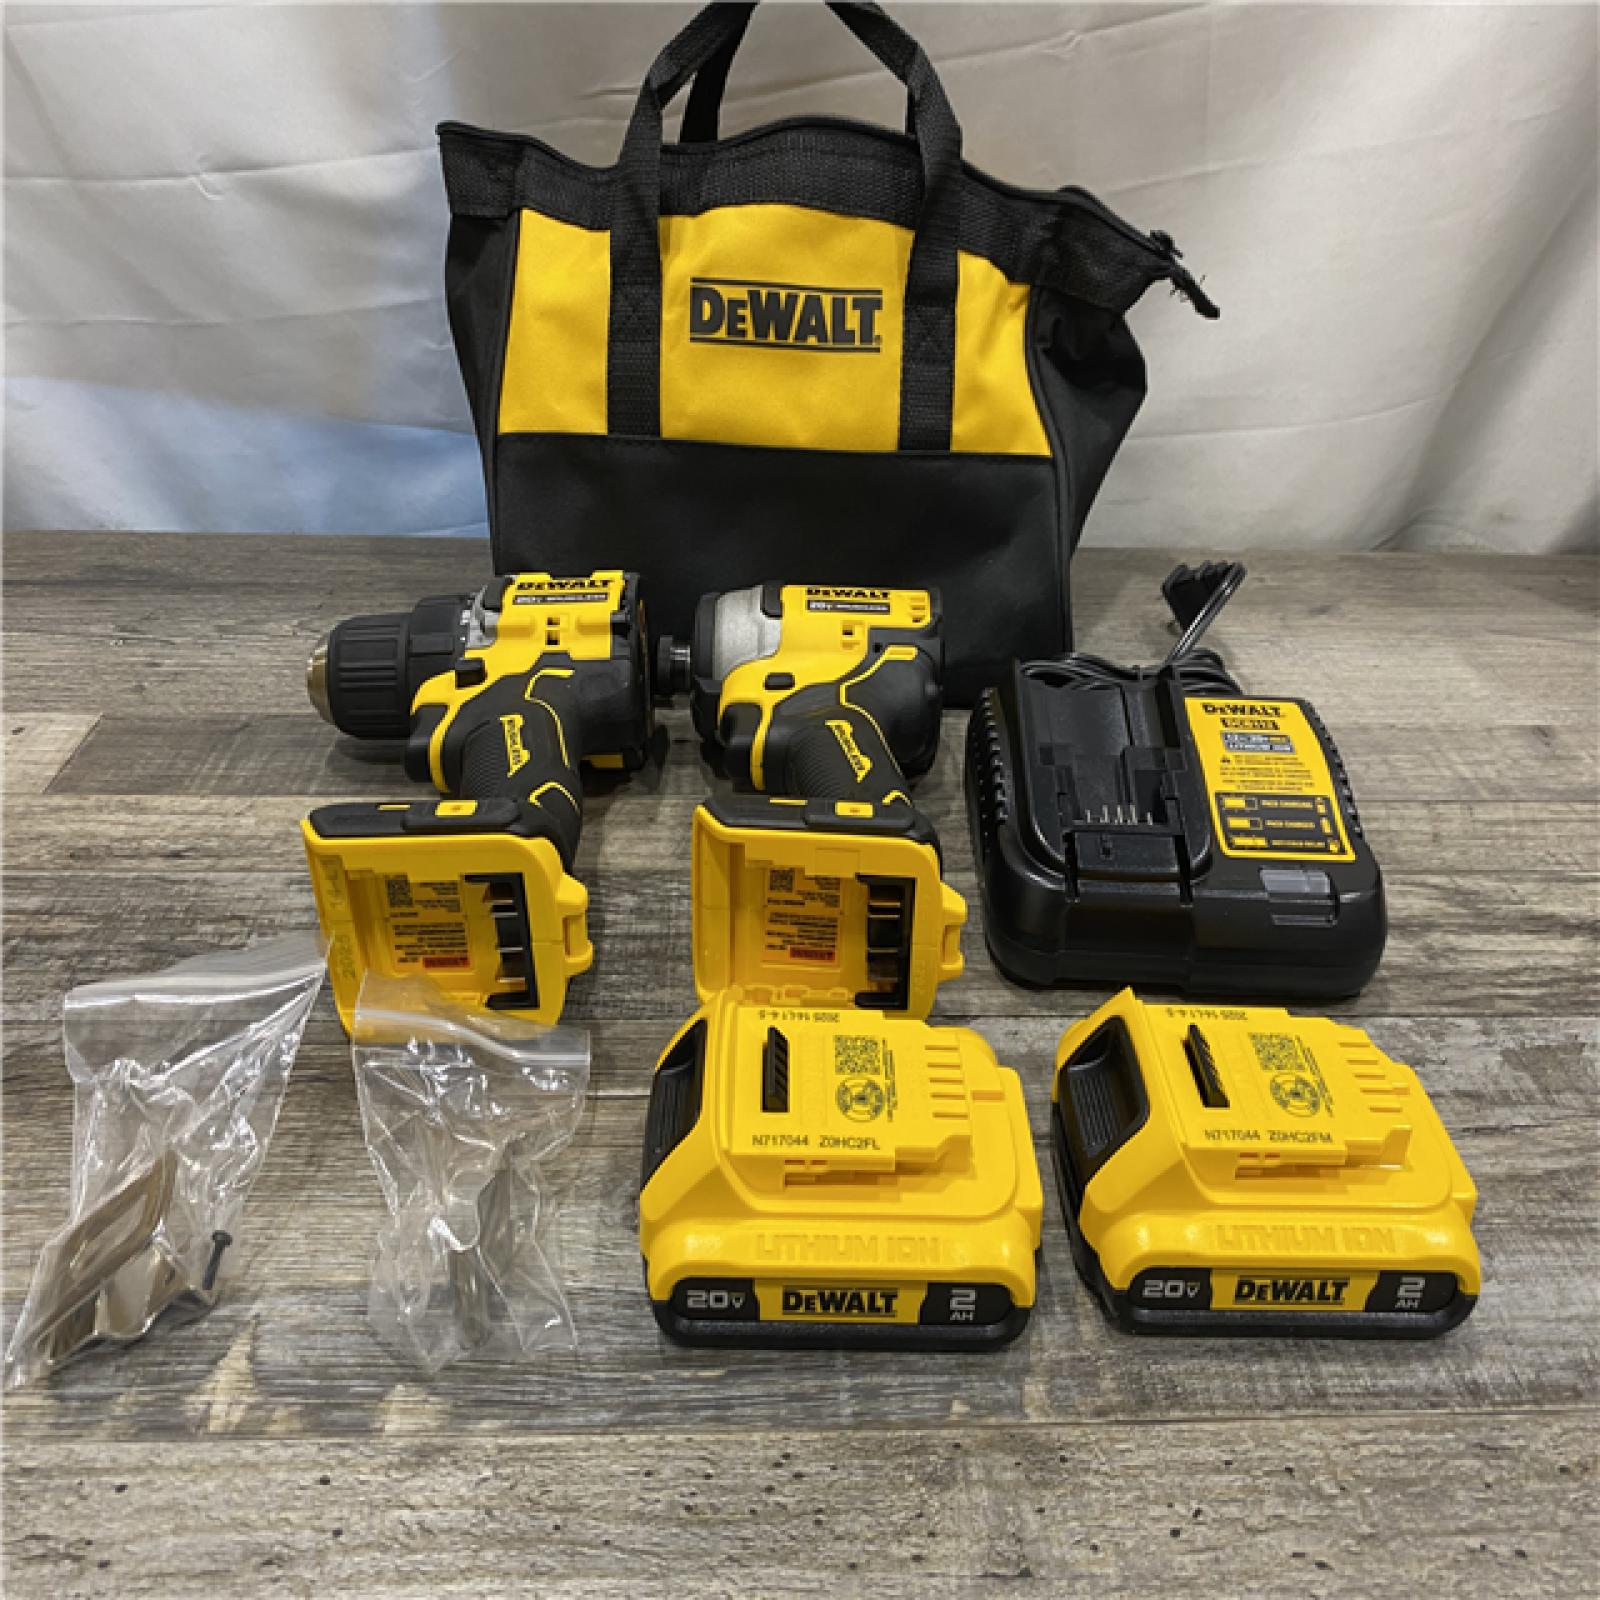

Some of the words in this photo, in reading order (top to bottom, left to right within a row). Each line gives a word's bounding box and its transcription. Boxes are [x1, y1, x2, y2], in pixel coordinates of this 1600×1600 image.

[690, 287, 882, 345] DEWALT
[757, 1233, 877, 1262] LITHIUM
[886, 1237, 940, 1265] ION
[1216, 1223, 1334, 1252] LITHIUM
[1343, 1227, 1397, 1254] ION
[783, 1288, 898, 1313] DEWALT
[949, 1289, 976, 1311] 2
[1235, 1279, 1349, 1301] DEWALT
[1397, 1277, 1426, 1299] 2
